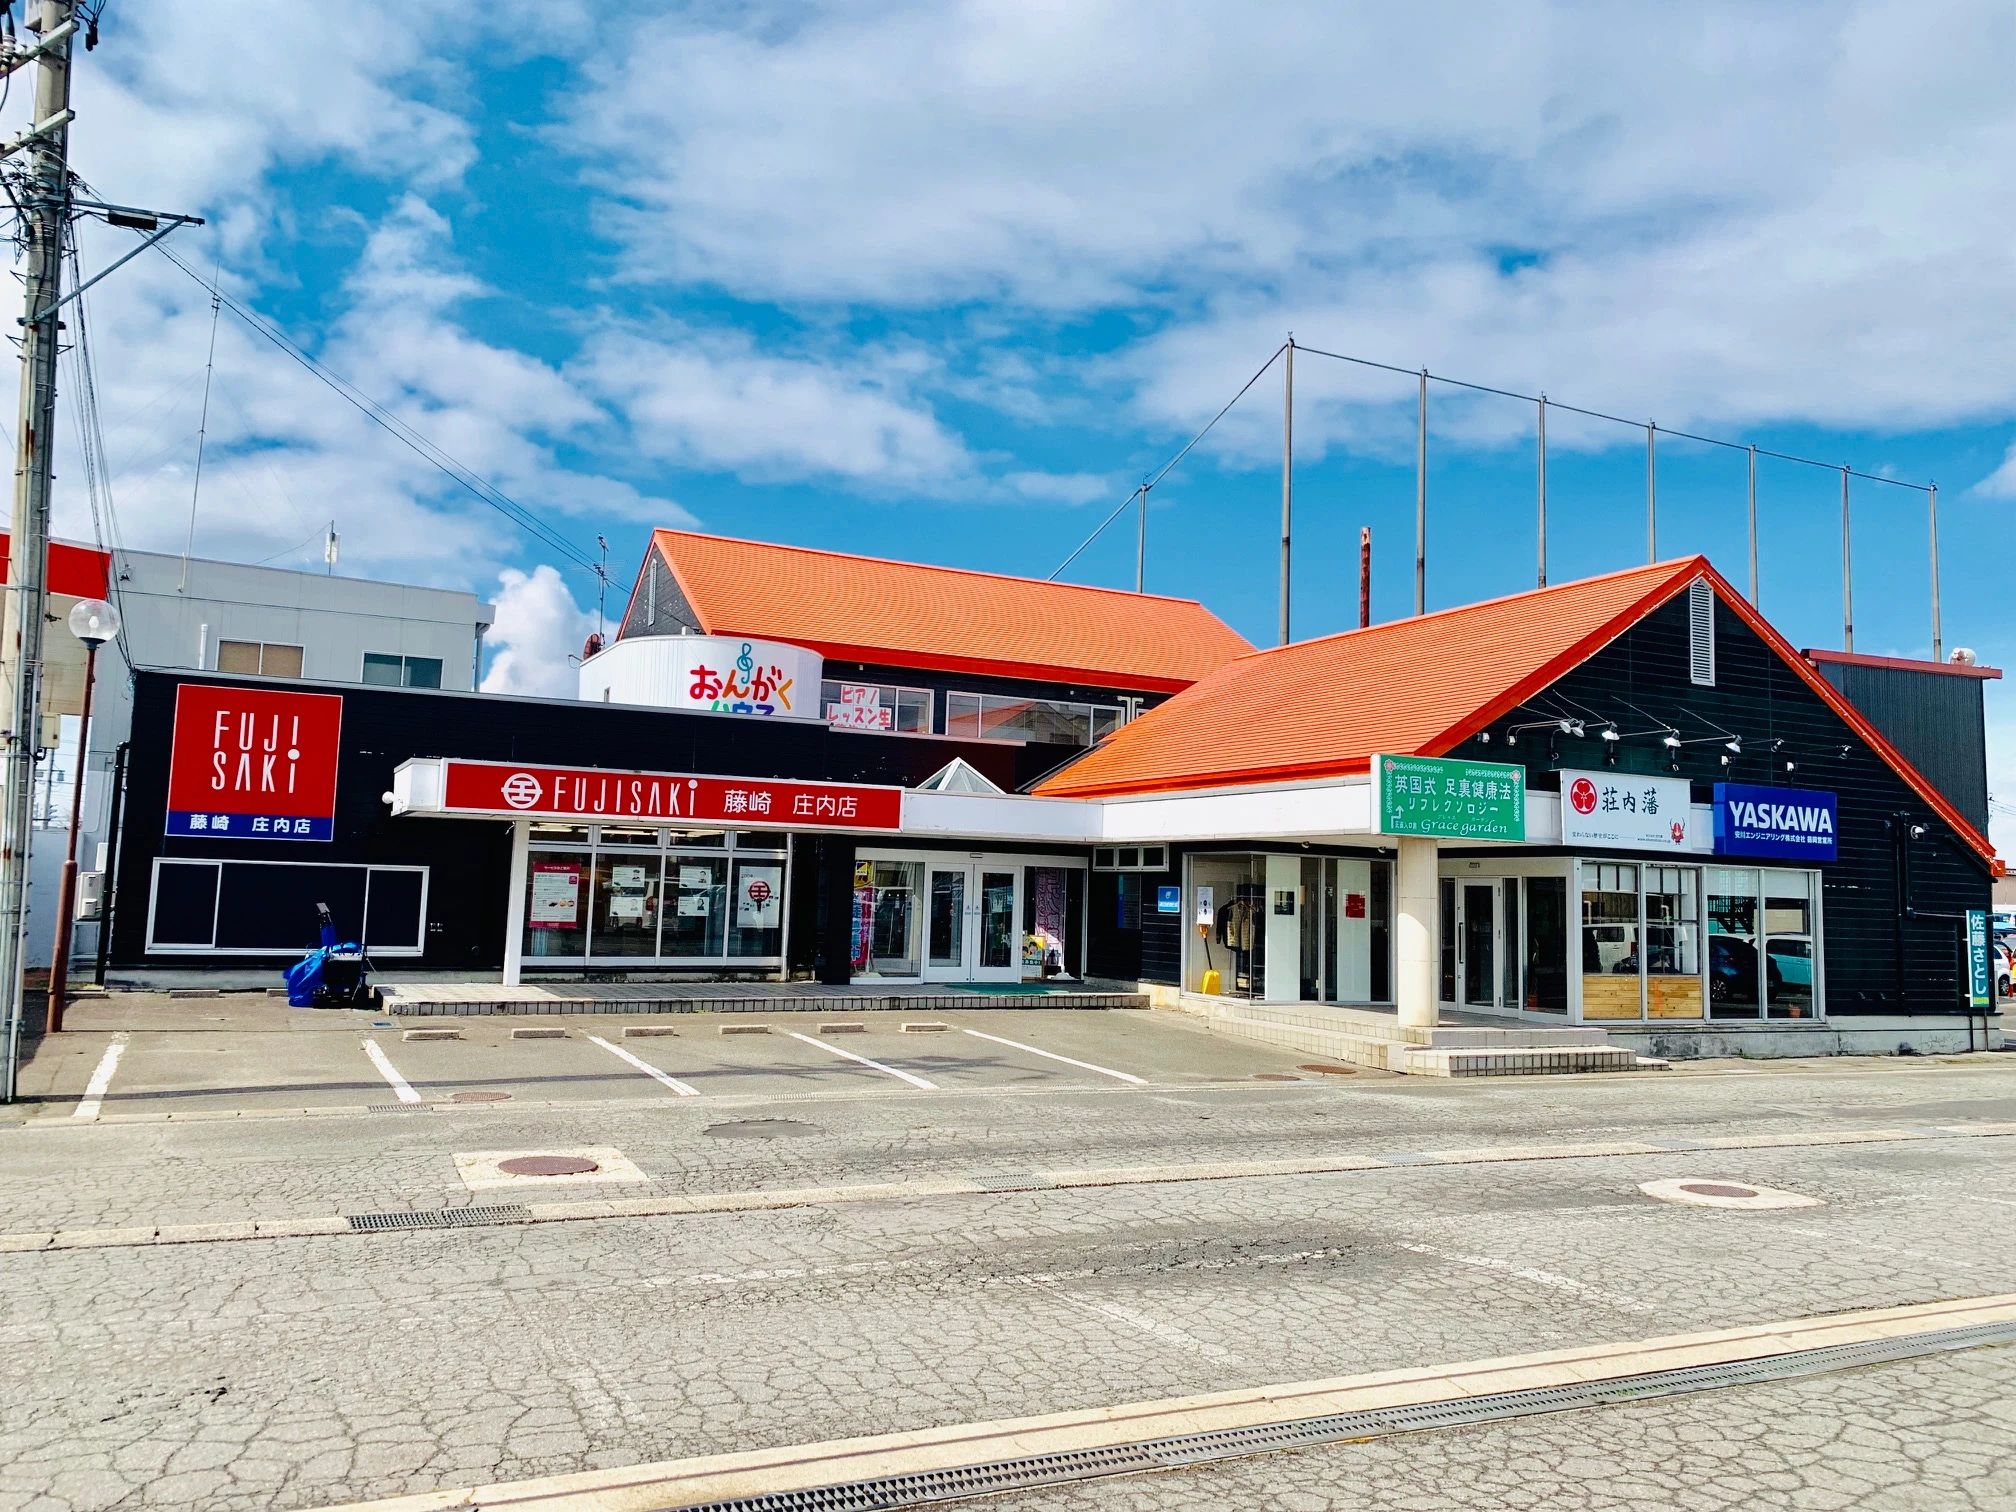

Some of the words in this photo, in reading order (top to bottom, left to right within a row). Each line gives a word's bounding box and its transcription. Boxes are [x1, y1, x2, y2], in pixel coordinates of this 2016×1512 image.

[690, 665, 793, 710] おんがく
[842, 687, 878, 704] ピアノ
[828, 705, 890, 727] レッスン生
[1395, 774, 1436, 796] 英国式
[1444, 778, 1511, 801] 足裏健康法
[1601, 786, 1660, 815] 荘内藩
[724, 789, 772, 815] 藤崎
[793, 794, 858, 818] 庄内店
[1409, 798, 1499, 815] リフレクソロジー
[1729, 800, 1833, 834] YASKAWA
[190, 814, 230, 832] 藤崎
[252, 816, 311, 834] 庄内店
[1421, 819, 1459, 833] Grace
[1460, 820, 1508, 836] garden
[1971, 914, 1987, 995] 佐藤さとし
